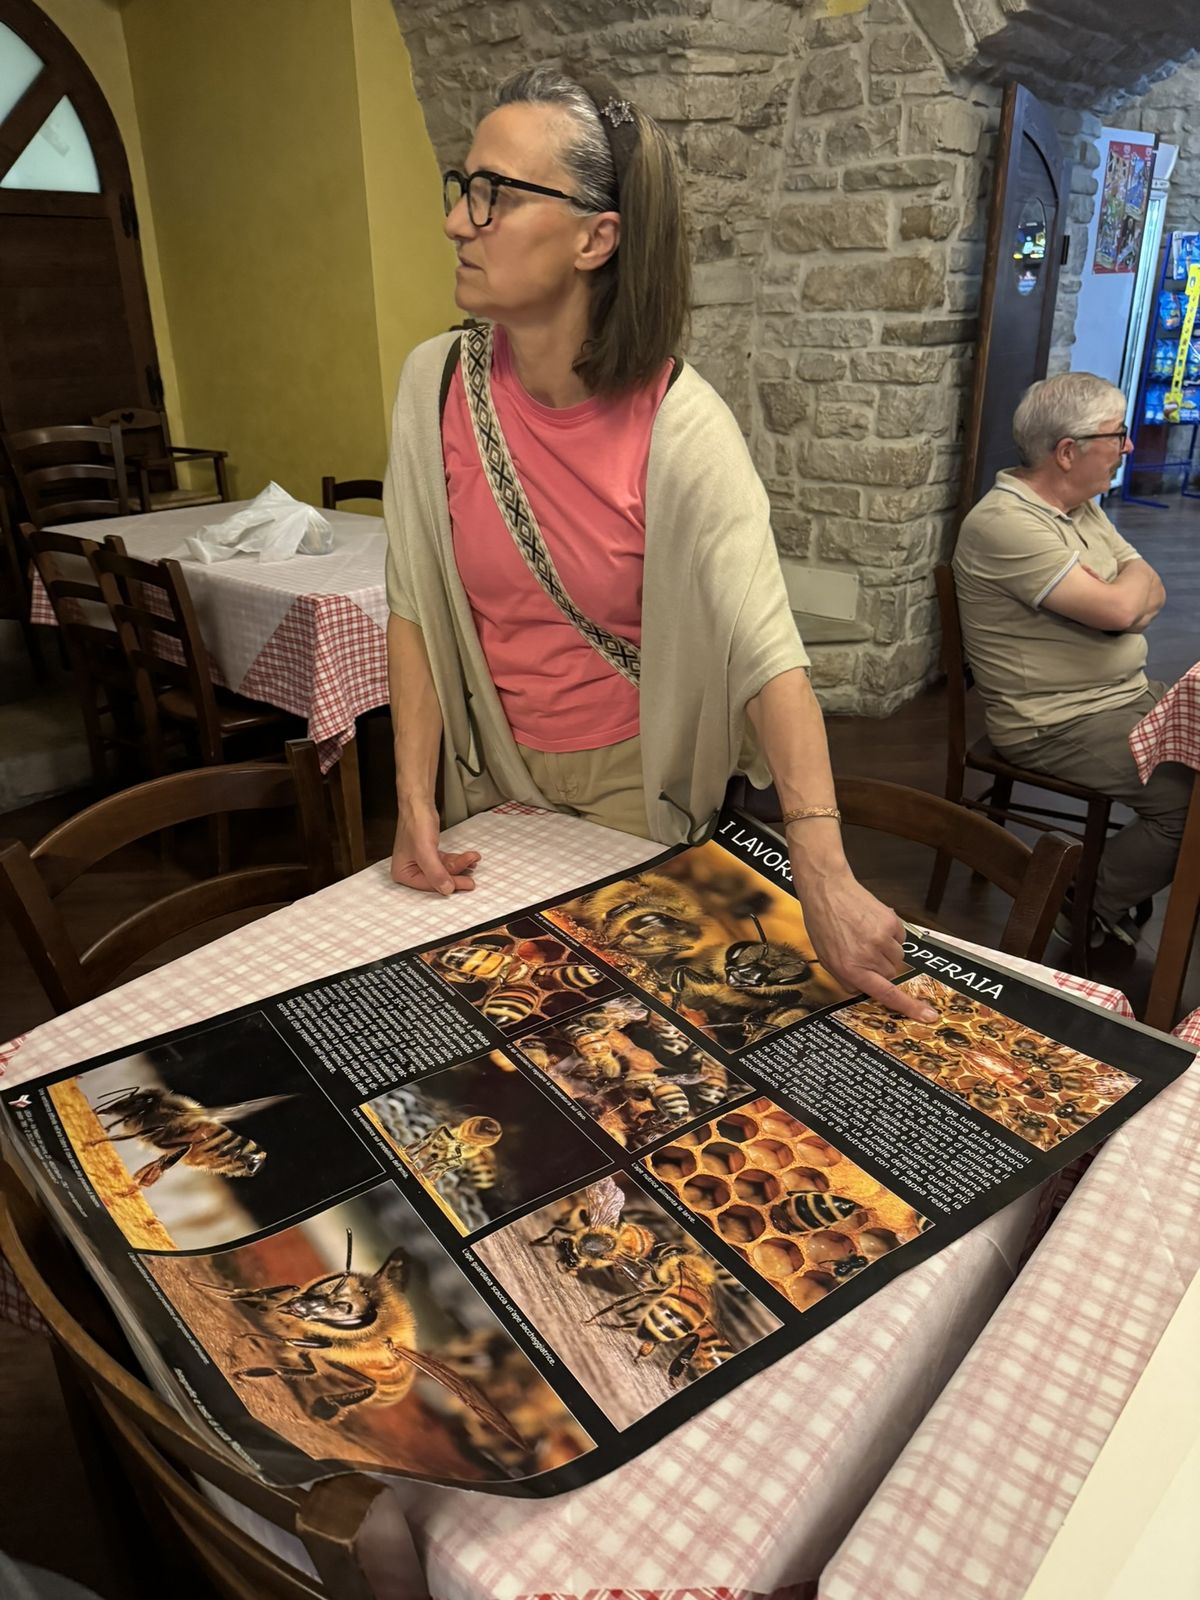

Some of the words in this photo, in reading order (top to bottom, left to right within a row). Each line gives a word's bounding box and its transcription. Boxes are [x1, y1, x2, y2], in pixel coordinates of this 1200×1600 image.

[718, 820, 736, 835] I
[902, 941, 1004, 1000] OPERAIA
[738, 1057, 781, 1088] accudiscono,
[788, 1093, 827, 1121] circondano
[842, 1132, 874, 1156] nutrono
[874, 1156, 889, 1168] con
[899, 1175, 926, 1195] pappa
[927, 1195, 954, 1215] reale.
[747, 1053, 773, 1072] anziane
[773, 1072, 785, 1082] con
[791, 1085, 816, 1103] polline
[827, 1111, 851, 1129] miele.
[862, 1136, 891, 1157] ancelle
[890, 1157, 924, 1182] dell'ape
[923, 1181, 952, 1202] regina
[754, 1049, 785, 1072] nutrendo
[792, 1076, 811, 1090] larve
[809, 1089, 823, 1099] più
[821, 1098, 849, 1118] giovani
[849, 1117, 863, 1128] con
[872, 1134, 898, 1153] pappa
[899, 1152, 921, 1168] reale
[927, 1173, 955, 1193] quelle
[954, 1192, 970, 1204] più
[768, 1042, 798, 1063] ricoprire
[804, 1066, 827, 1083] pareti,
[828, 1083, 864, 1108] rinforzare
[872, 1113, 901, 1135] cellette
[912, 1142, 929, 1154] favi
[935, 1158, 985, 1193] imbalsama-
[772, 1054, 791, 1067] corpi
[791, 1066, 803, 1075] dei
[802, 1074, 826, 1091] nemici
[826, 1090, 848, 1107] morti.
[847, 1106, 869, 1122] L'ape
[868, 1121, 897, 1141] nutrice
[896, 1140, 936, 1169] accudisce
[944, 1175, 978, 1200] covata,
[777, 1038, 800, 1055] morte.
[803, 1056, 829, 1074] Utilizza
[836, 1080, 863, 1099] propoli
[863, 1099, 877, 1109] per
[877, 1108, 909, 1131] sigillare
[919, 1137, 950, 1159] fessure
[949, 1158, 993, 1190] dell'arnia,
[784, 1034, 806, 1049] miele.
[805, 1049, 825, 1063] L'ape
[824, 1062, 856, 1084] spazzina
[855, 1083, 876, 1098] porta
[876, 1097, 895, 1111] fuori
[904, 1117, 940, 1142] sporcizia
[956, 1153, 1001, 1184] compagne
[791, 1030, 806, 1041] rate
[805, 1041, 819, 1050] per
[818, 1049, 855, 1075] accogliere
[863, 1080, 883, 1094] uova,
[894, 1101, 916, 1116] larve,
[928, 1123, 954, 1141] scorte
[964, 1147, 993, 1168] polline
[805, 1031, 828, 1047] dedica
[828, 1047, 842, 1057] alla
[841, 1056, 866, 1073] pulizia
[865, 1072, 884, 1085] delle
[884, 1084, 913, 1104] cellette
[912, 1103, 928, 1114] che
[928, 1114, 958, 1135] devono
[958, 1134, 985, 1154] essere
[985, 1154, 1015, 1174] prepa-
[806, 1023, 842, 1048] necessarie
[842, 1047, 856, 1057] alla
[856, 1056, 898, 1085] sussistenza
[898, 1084, 944, 1116] dell'alveare.
[945, 1115, 969, 1132] Come
[969, 1132, 995, 1150] primo
[996, 1149, 1024, 1168] lavoro
[812, 1020, 831, 1033] L'ape
[830, 1032, 860, 1052] operaia,
[861, 1051, 890, 1070] durante
[899, 1076, 913, 1086] sua
[913, 1086, 932, 1099] vita,
[932, 1098, 959, 1117] svolge
[960, 1116, 981, 1130] tutte
[992, 1136, 1031, 1163] mansioni
[631, 1161, 645, 1174] L'ape
[643, 1172, 660, 1187] nutrice
[658, 1186, 679, 1206] alimenta
[682, 1209, 697, 1223] larve.
[461, 1248, 475, 1262] L'ape
[471, 1260, 494, 1286] guardiana
[491, 1285, 508, 1304] scaccia
[505, 1303, 522, 1323] un'ape
[519, 1321, 556, 1366] saccheggiatrice.
